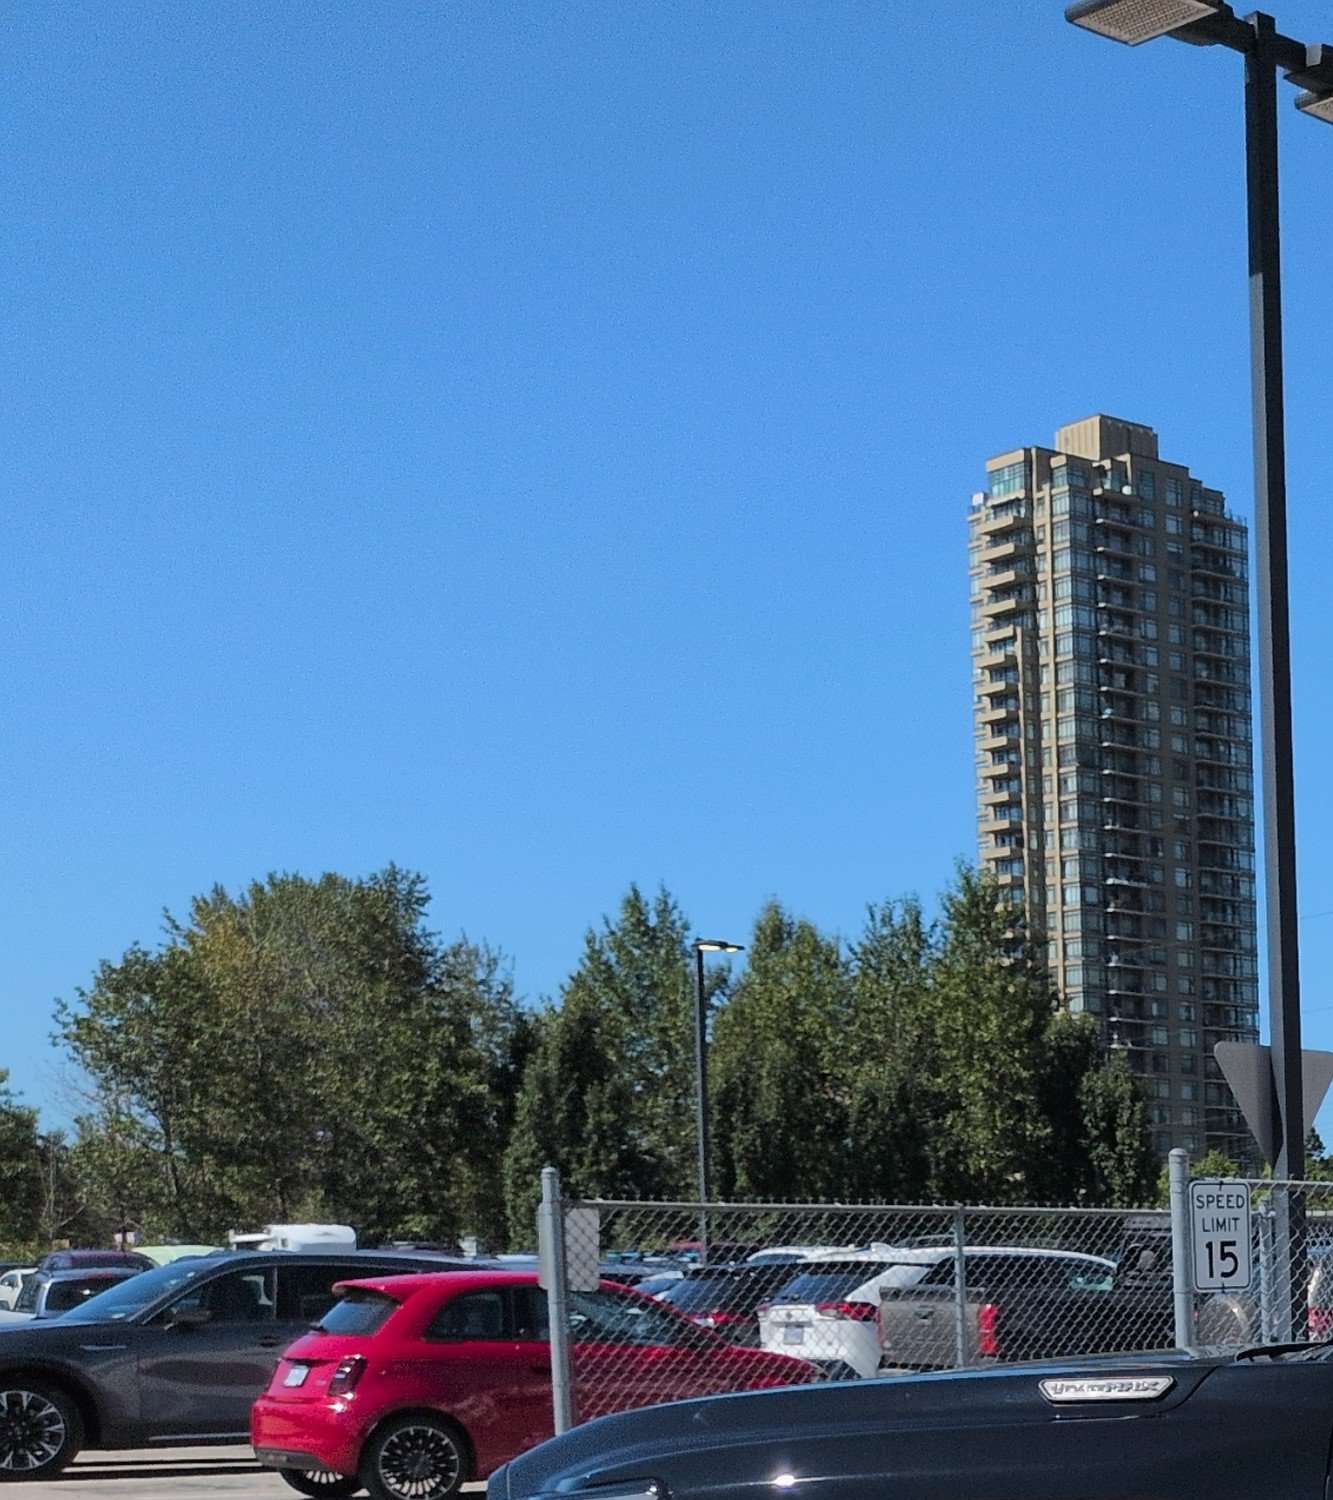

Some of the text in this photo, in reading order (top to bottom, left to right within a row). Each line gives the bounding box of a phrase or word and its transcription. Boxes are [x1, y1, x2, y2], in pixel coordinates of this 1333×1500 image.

[1195, 1194, 1245, 1210] SPEED
[1202, 1217, 1240, 1233] LIMIT
[1205, 1240, 1238, 1278] 15
